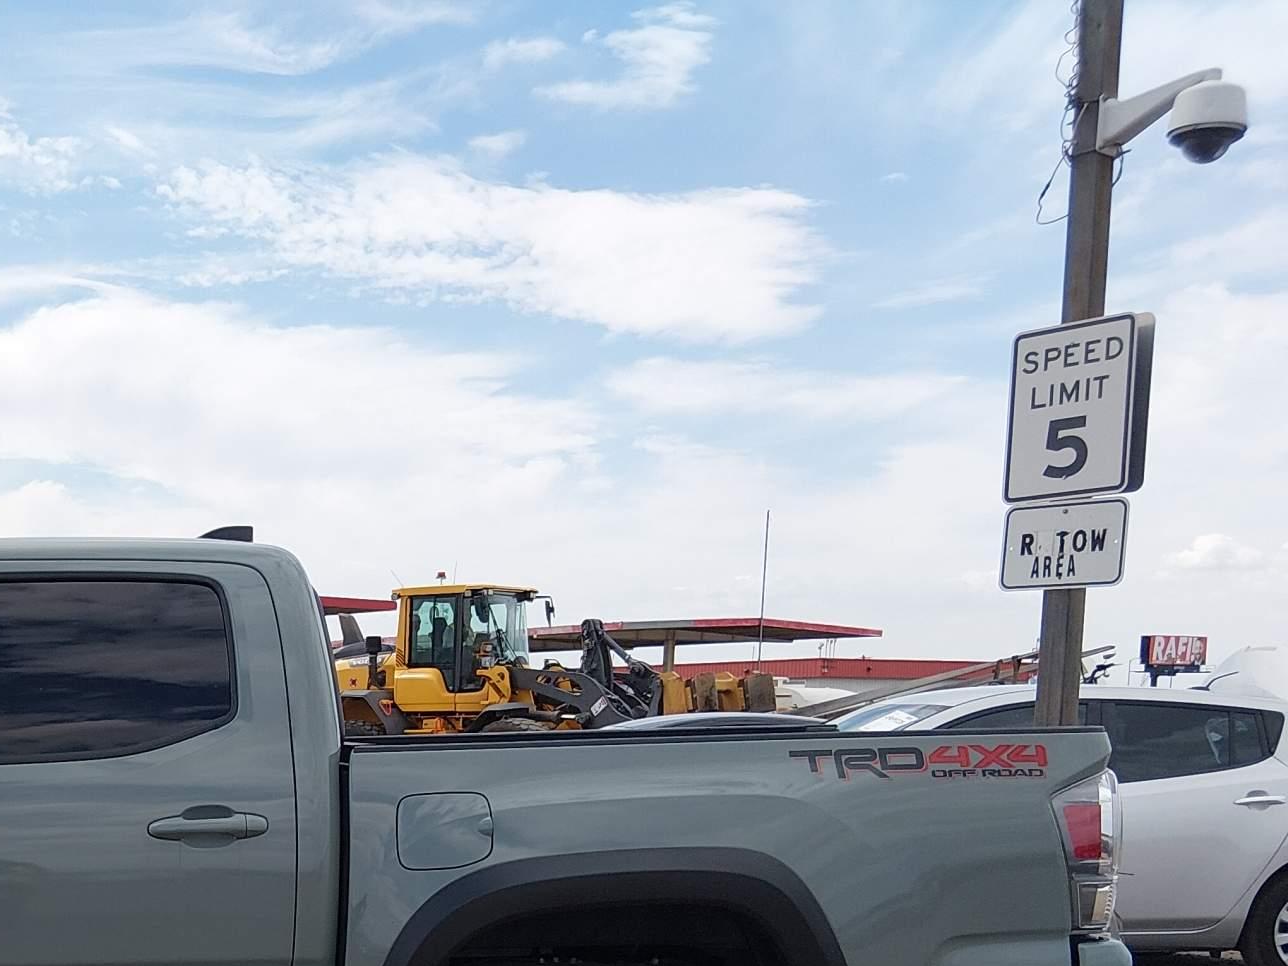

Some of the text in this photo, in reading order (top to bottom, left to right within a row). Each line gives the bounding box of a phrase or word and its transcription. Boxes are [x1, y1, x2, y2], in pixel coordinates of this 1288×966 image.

[1022, 336, 1124, 375] SPEED
[1030, 374, 1110, 410] LIMIT
[1042, 415, 1088, 480] 5
[1056, 528, 1107, 555] TOW
[1030, 554, 1076, 579] AREA
[788, 747, 928, 782] TRD
[931, 767, 1047, 779] OFF ROAD
